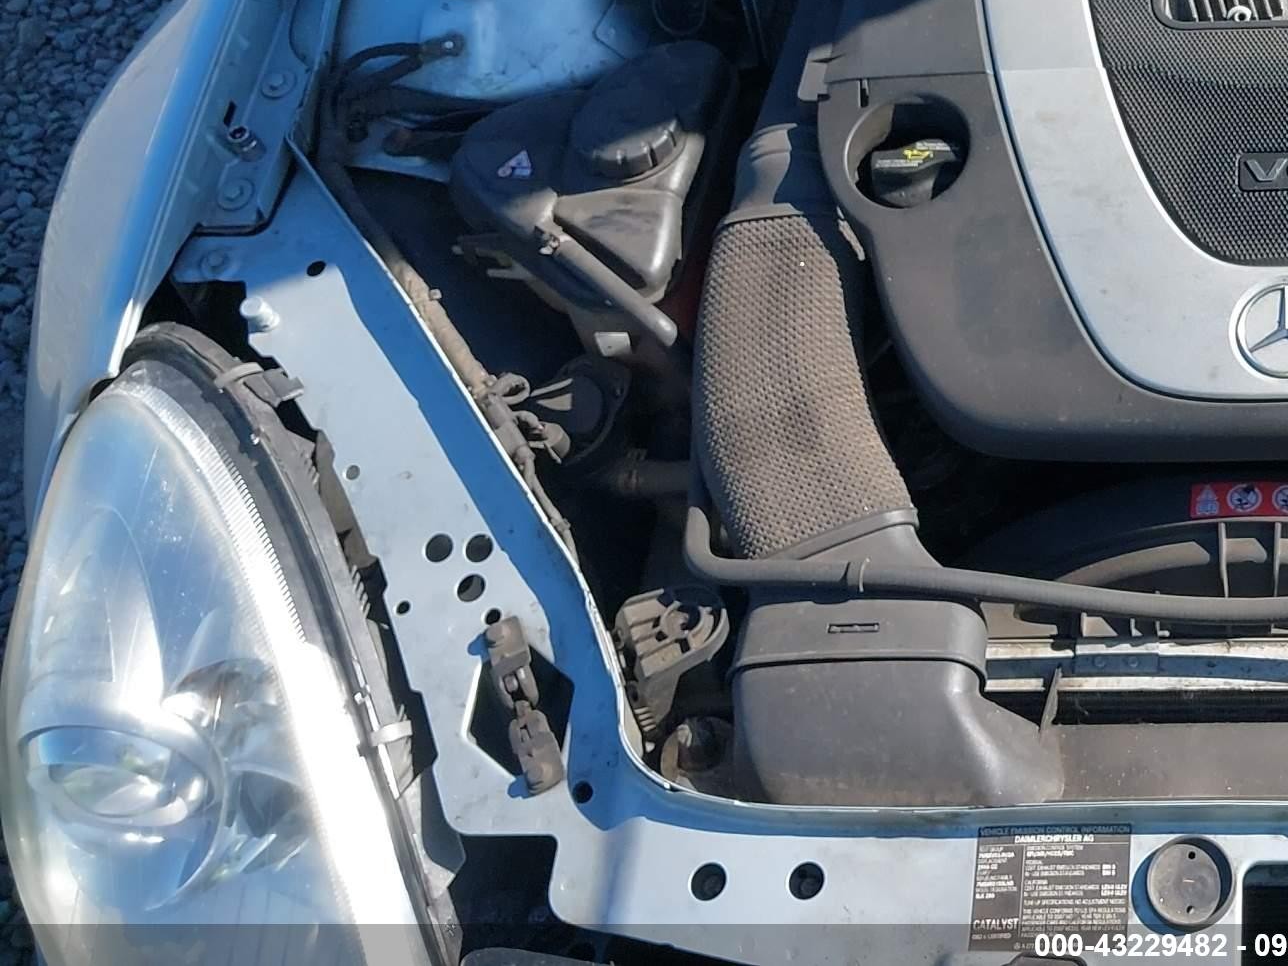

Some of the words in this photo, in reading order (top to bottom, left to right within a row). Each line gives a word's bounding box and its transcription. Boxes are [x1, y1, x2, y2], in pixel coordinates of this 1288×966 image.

[1047, 826, 1079, 834] CONTROL
[1081, 825, 1130, 834] INFORMATION
[1014, 835, 1082, 843] DAIMLERCHRYSLER
[1082, 834, 1095, 842] AG
[972, 917, 1019, 930] CATALYST
